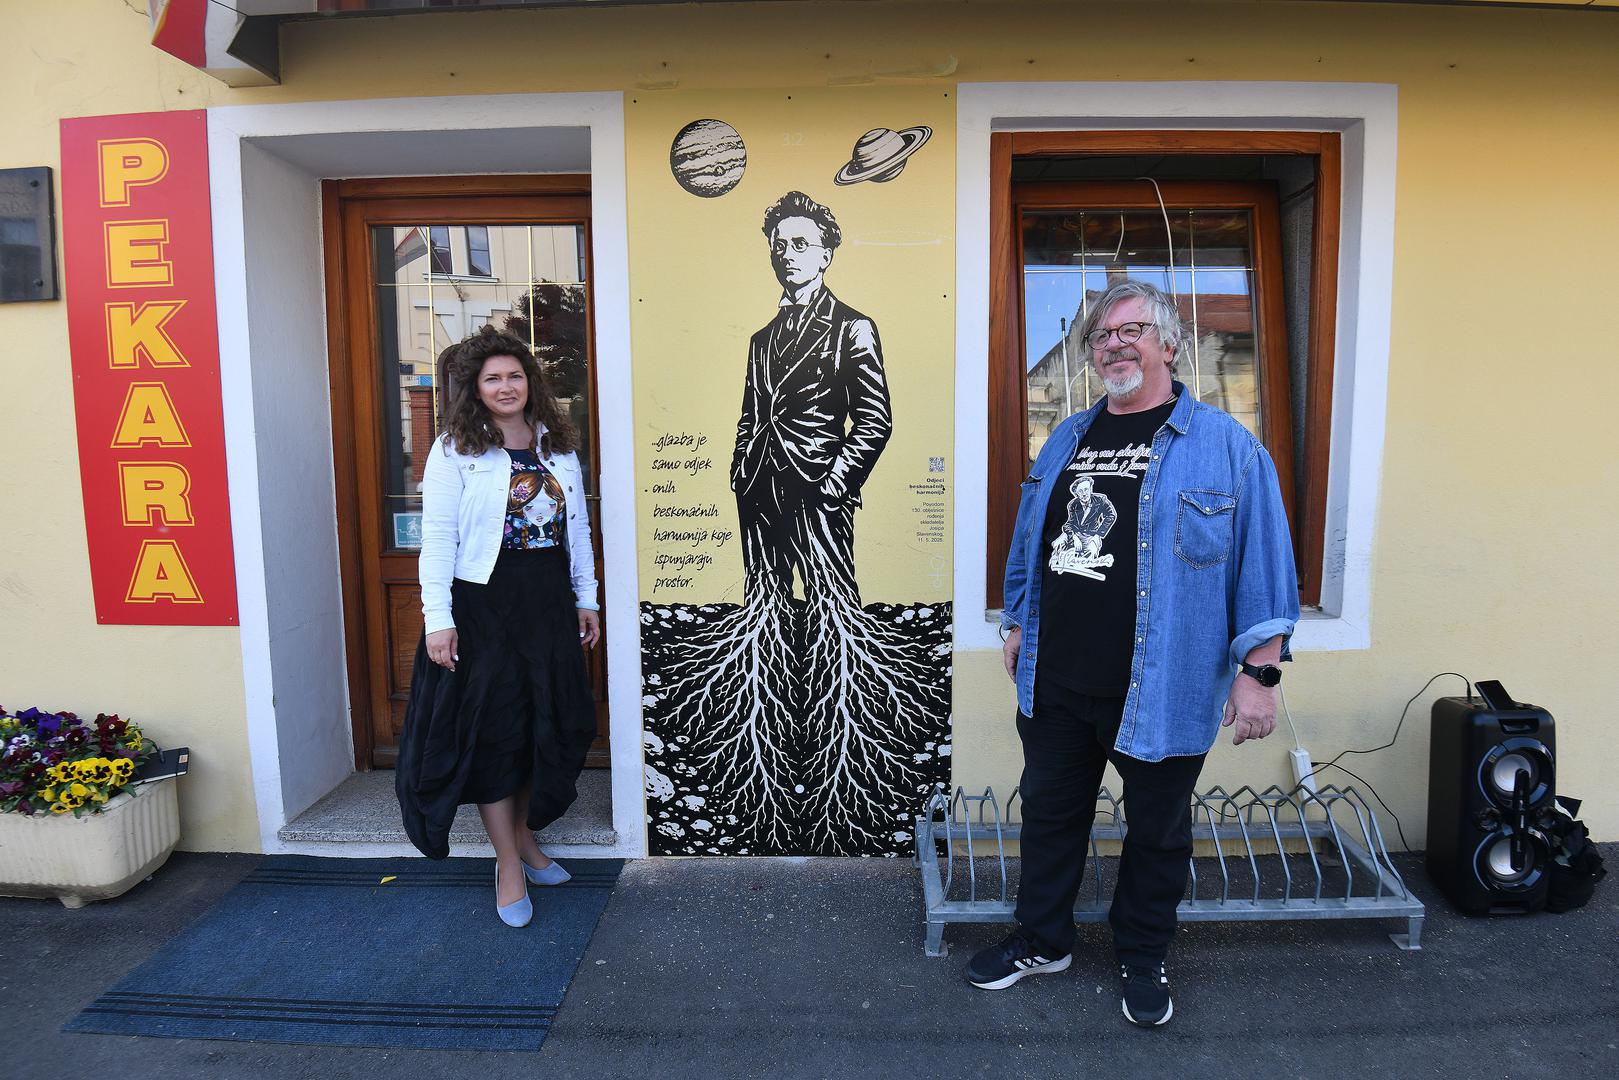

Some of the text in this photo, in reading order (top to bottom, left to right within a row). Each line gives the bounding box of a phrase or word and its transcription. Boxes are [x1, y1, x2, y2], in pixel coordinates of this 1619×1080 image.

[97, 137, 205, 604] PEKARA
[692, 432, 708, 452] je
[652, 457, 712, 476] samo odjek
[652, 480, 677, 494] onih
[653, 503, 720, 518] beskonačnih
[653, 527, 733, 547] harmonija koje
[654, 551, 713, 570] ispunjavaju
[653, 574, 695, 593] prostor.
